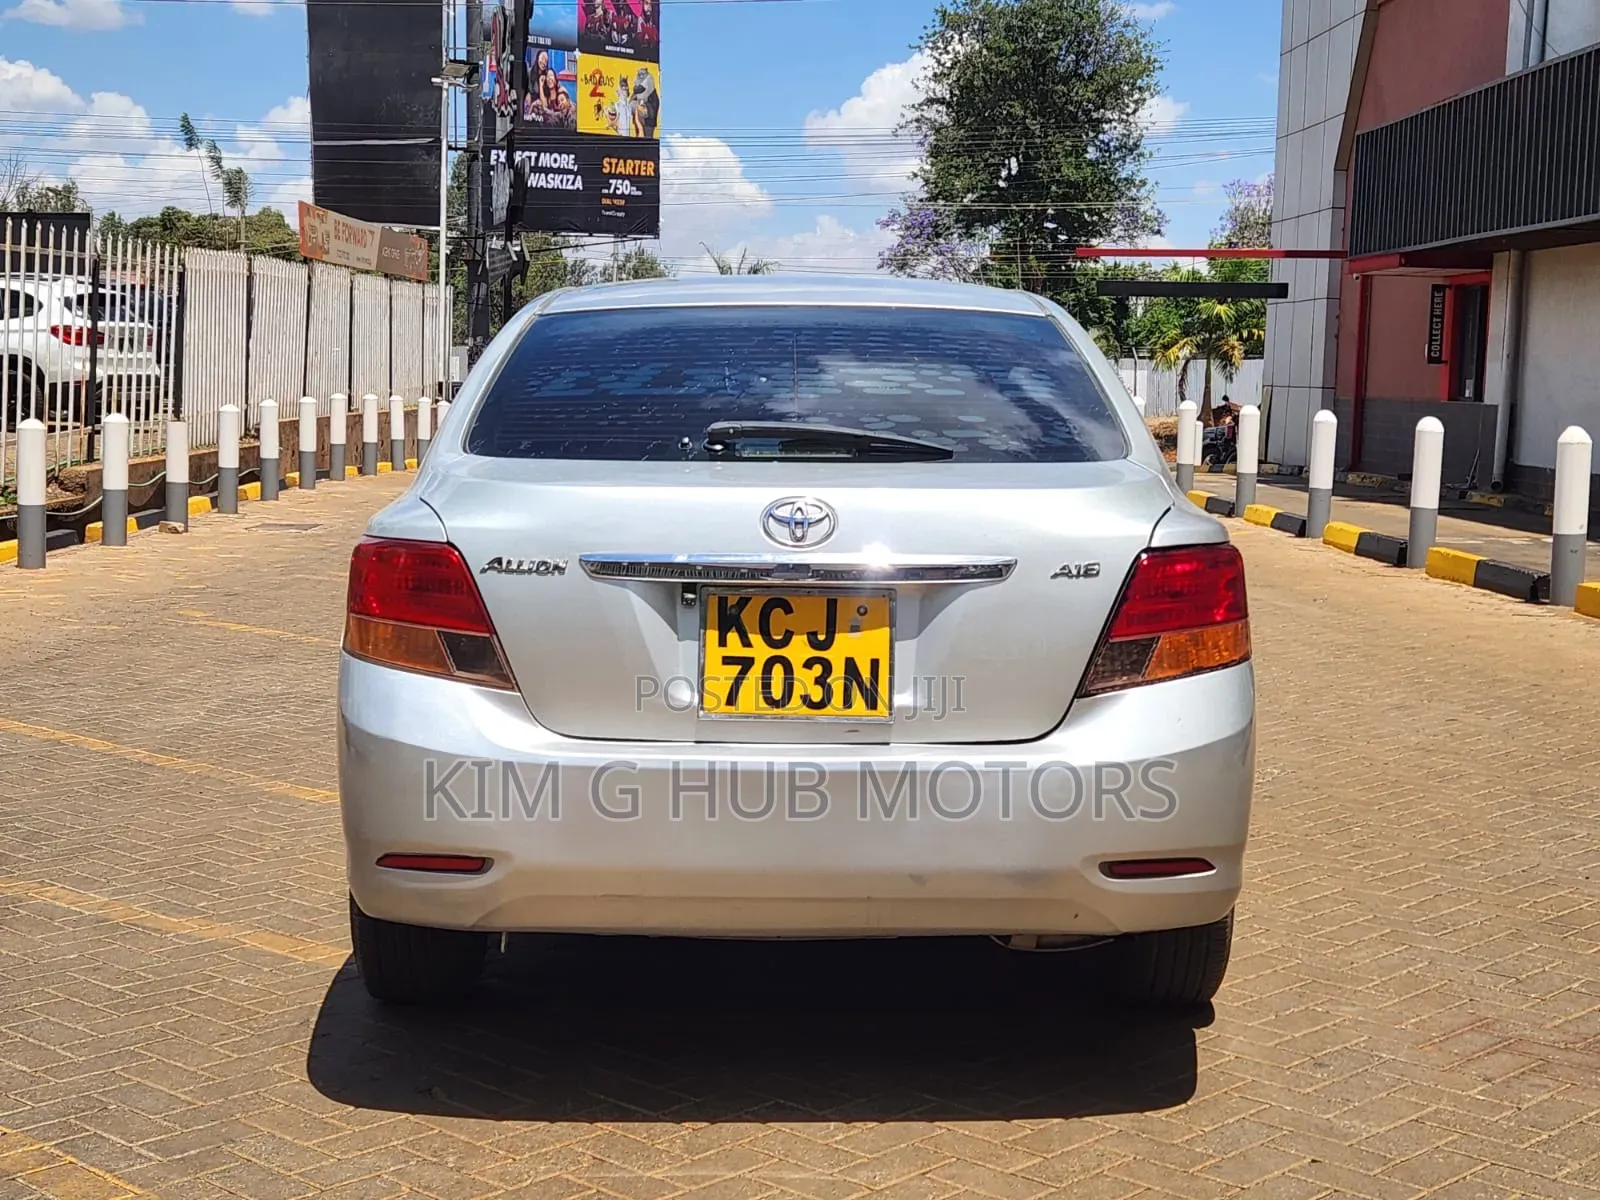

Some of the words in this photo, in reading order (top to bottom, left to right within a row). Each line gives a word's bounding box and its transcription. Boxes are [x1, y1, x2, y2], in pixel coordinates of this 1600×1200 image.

[538, 152, 578, 172] MORE,
[602, 157, 655, 176] STARTER
[609, 179, 631, 195] 750
[1434, 291, 1444, 315] HERE
[1431, 317, 1442, 357] COLLECT
[479, 556, 569, 577] ALLION
[717, 596, 838, 652] KCJ
[721, 655, 880, 712] 703N
